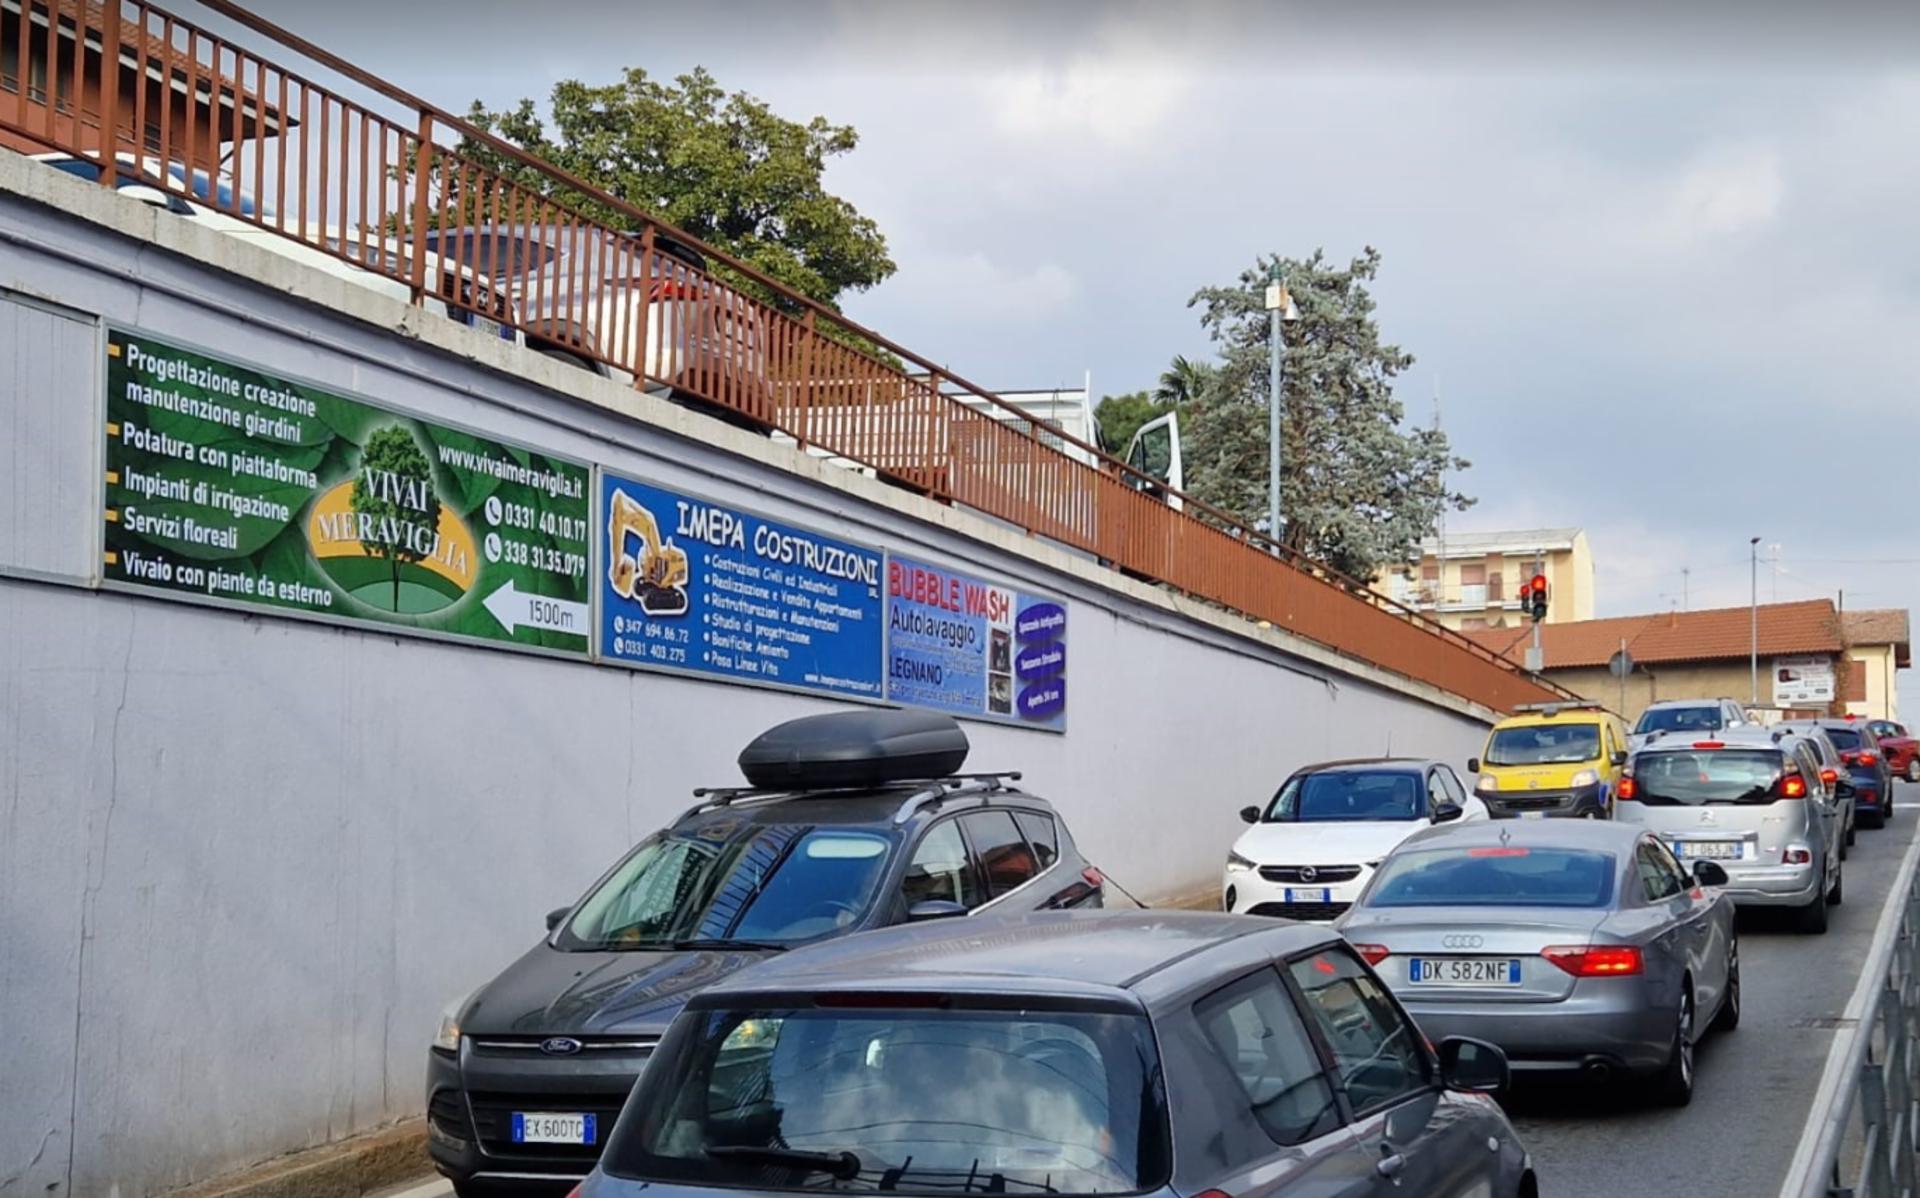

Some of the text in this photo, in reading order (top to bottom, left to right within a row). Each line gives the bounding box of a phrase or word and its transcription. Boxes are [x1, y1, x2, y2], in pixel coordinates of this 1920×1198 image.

[126, 344, 316, 418] Progettazione creazione
[126, 382, 301, 443] manutenzione giardini
[123, 422, 317, 489] Potatura con piattaforma
[438, 445, 583, 498] www.vivaimeraviglia.it
[125, 466, 289, 522] Impianti di irrigazione
[364, 467, 428, 512] VIVAI
[124, 507, 237, 549] Servizi floreali
[505, 503, 586, 541] 0331 40.10.17
[318, 513, 468, 576] MERAVIGLIA
[504, 541, 585, 577] 338 31.35.079
[677, 501, 878, 585] IMEPA COSTRUZIONI
[123, 550, 332, 606] Vivaio con piante da esterno
[711, 573, 770, 599] Realizzazione
[772, 591, 778, 601] e
[712, 554, 760, 578] Costruzioni
[785, 574, 796, 587] ed
[798, 575, 838, 597] Industriali
[889, 561, 1009, 625] BUBBLE WASH
[528, 599, 573, 628] 1500m
[625, 619, 642, 634] 347
[711, 593, 779, 620] Ristrutturazioni
[782, 612, 788, 622] e
[891, 604, 976, 649] Autolavaggio
[625, 640, 646, 656] 0331
[711, 631, 789, 659] Bonifiche Amianto
[712, 613, 811, 645] Studio di progettazione
[711, 651, 732, 668] Posa
[761, 659, 778, 676] Vita
[889, 655, 943, 685] LEGNANO
[1422, 961, 1507, 980] DK 582NF
[525, 1118, 540, 1138] EX
